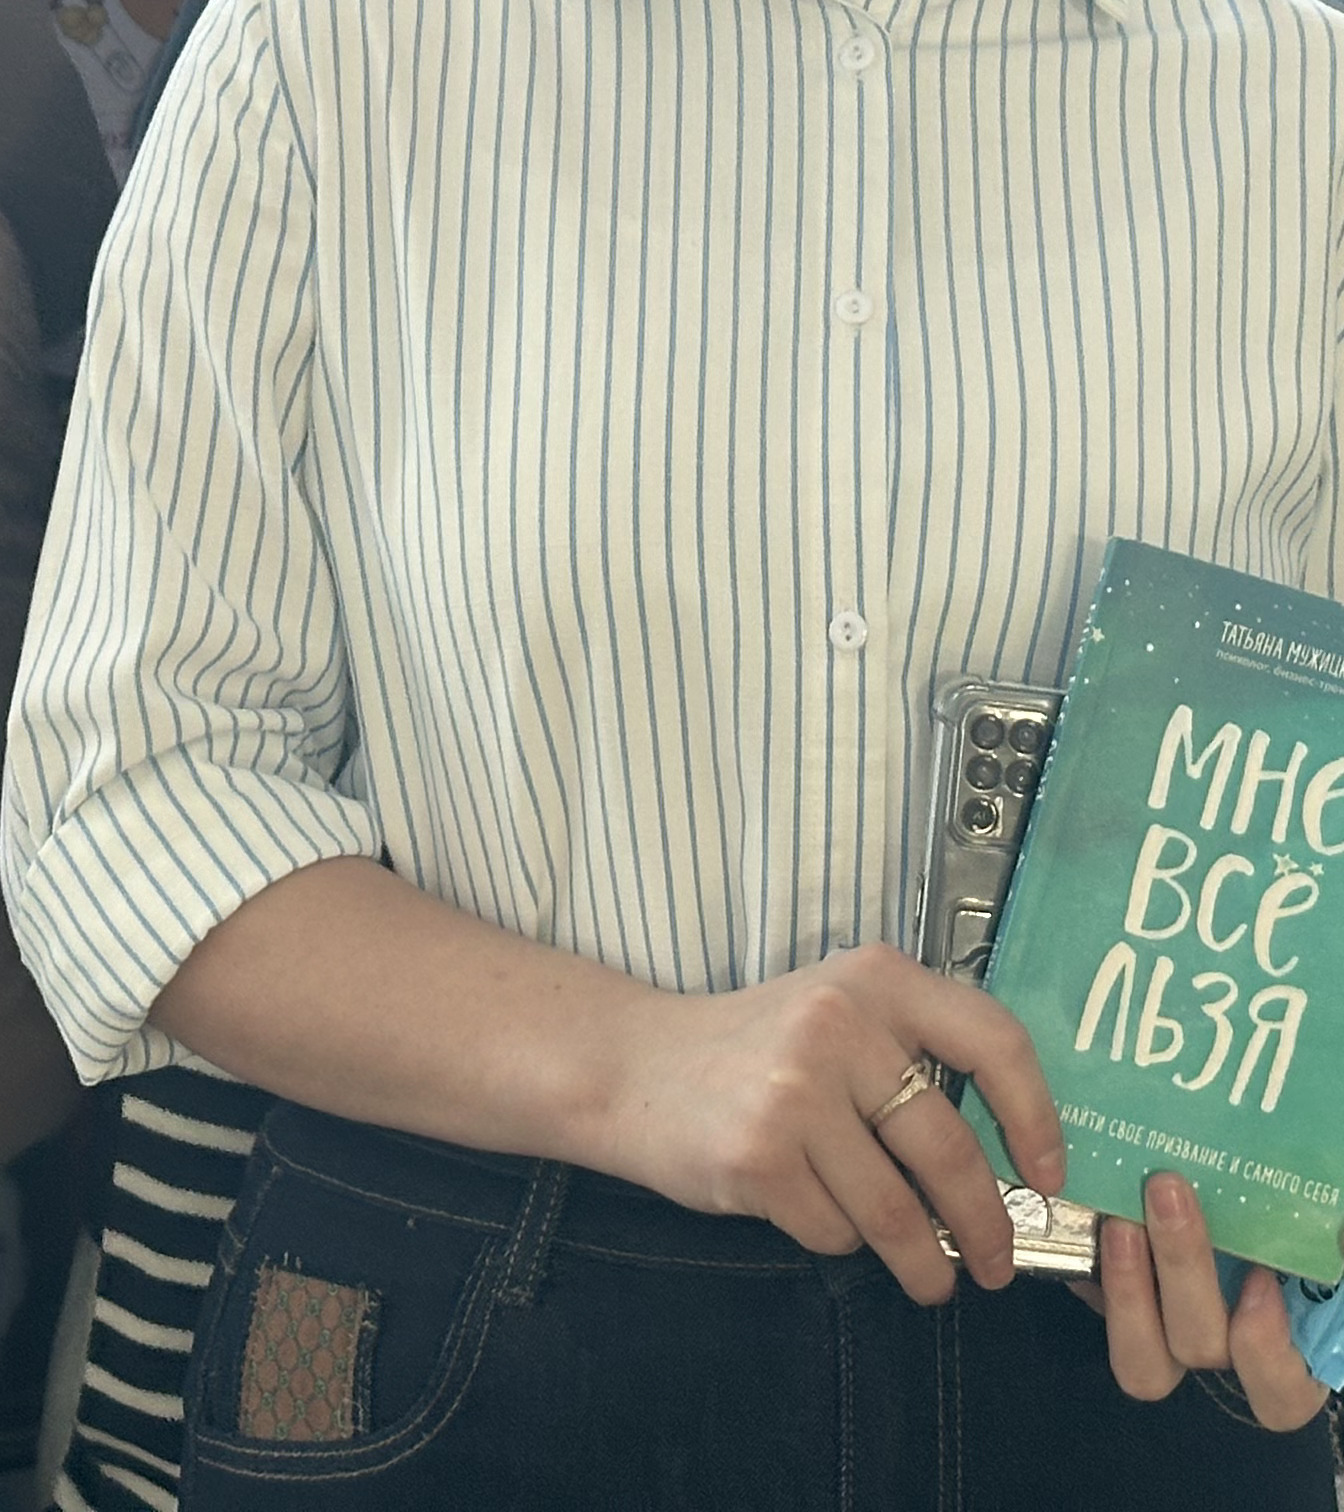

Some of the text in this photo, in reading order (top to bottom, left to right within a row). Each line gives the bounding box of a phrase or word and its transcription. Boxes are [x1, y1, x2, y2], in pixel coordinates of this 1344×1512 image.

[1221, 621, 1284, 660] ТАТЬЯНА
[1074, 941, 1308, 1114] ЛЬЗЯ
[1060, 1103, 1341, 1208] НАЙТИ СВОЕ ПРИЗВАНИЕ И САМОГО СЕБЯ
